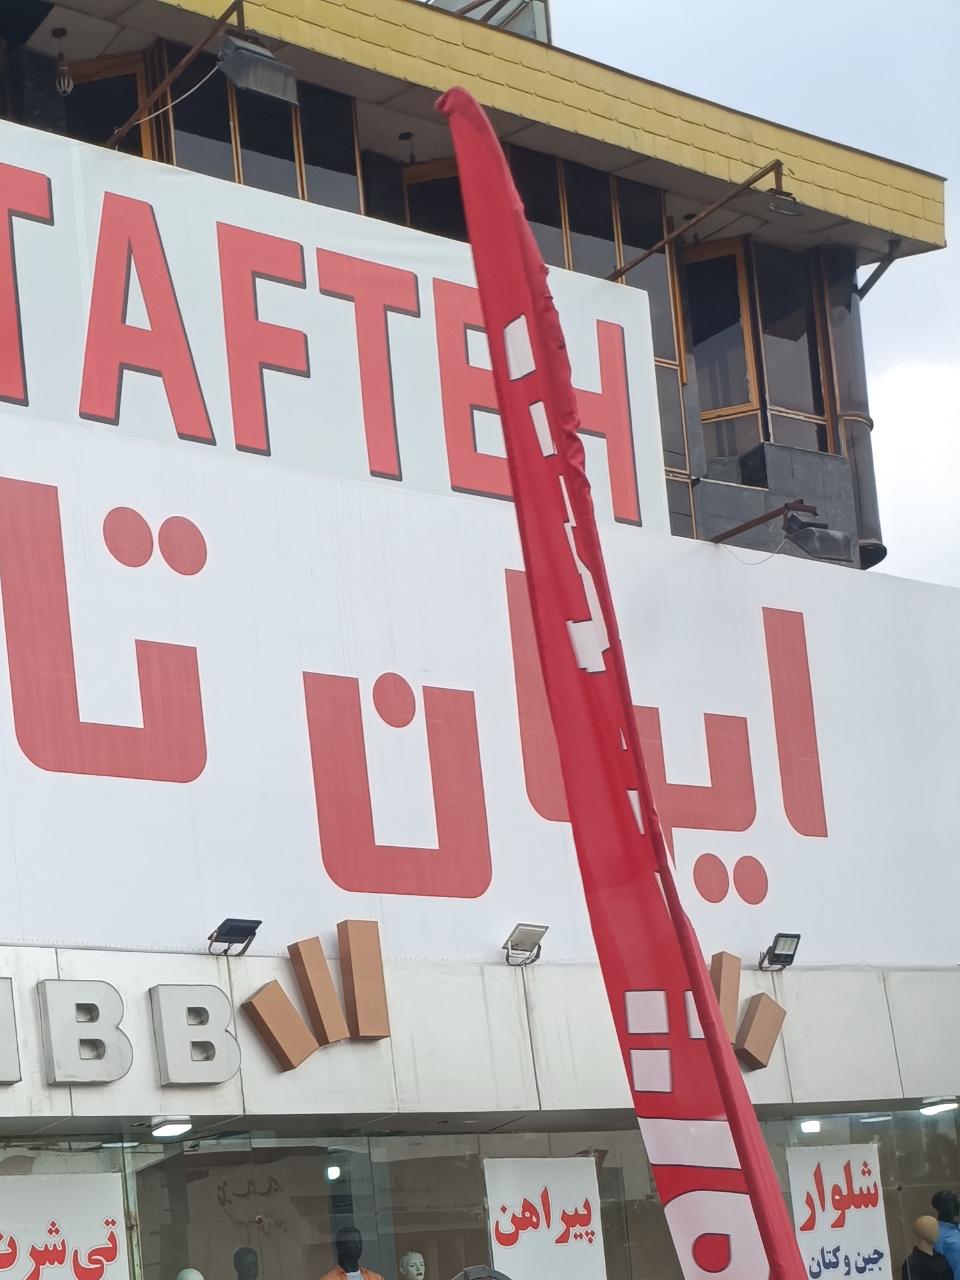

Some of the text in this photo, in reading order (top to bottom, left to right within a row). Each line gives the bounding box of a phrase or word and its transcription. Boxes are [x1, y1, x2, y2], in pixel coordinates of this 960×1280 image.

[494, 1186, 596, 1247] پیراهن
[800, 1160, 880, 1233] شلوار
[808, 1246, 885, 1280] جین و کتان
